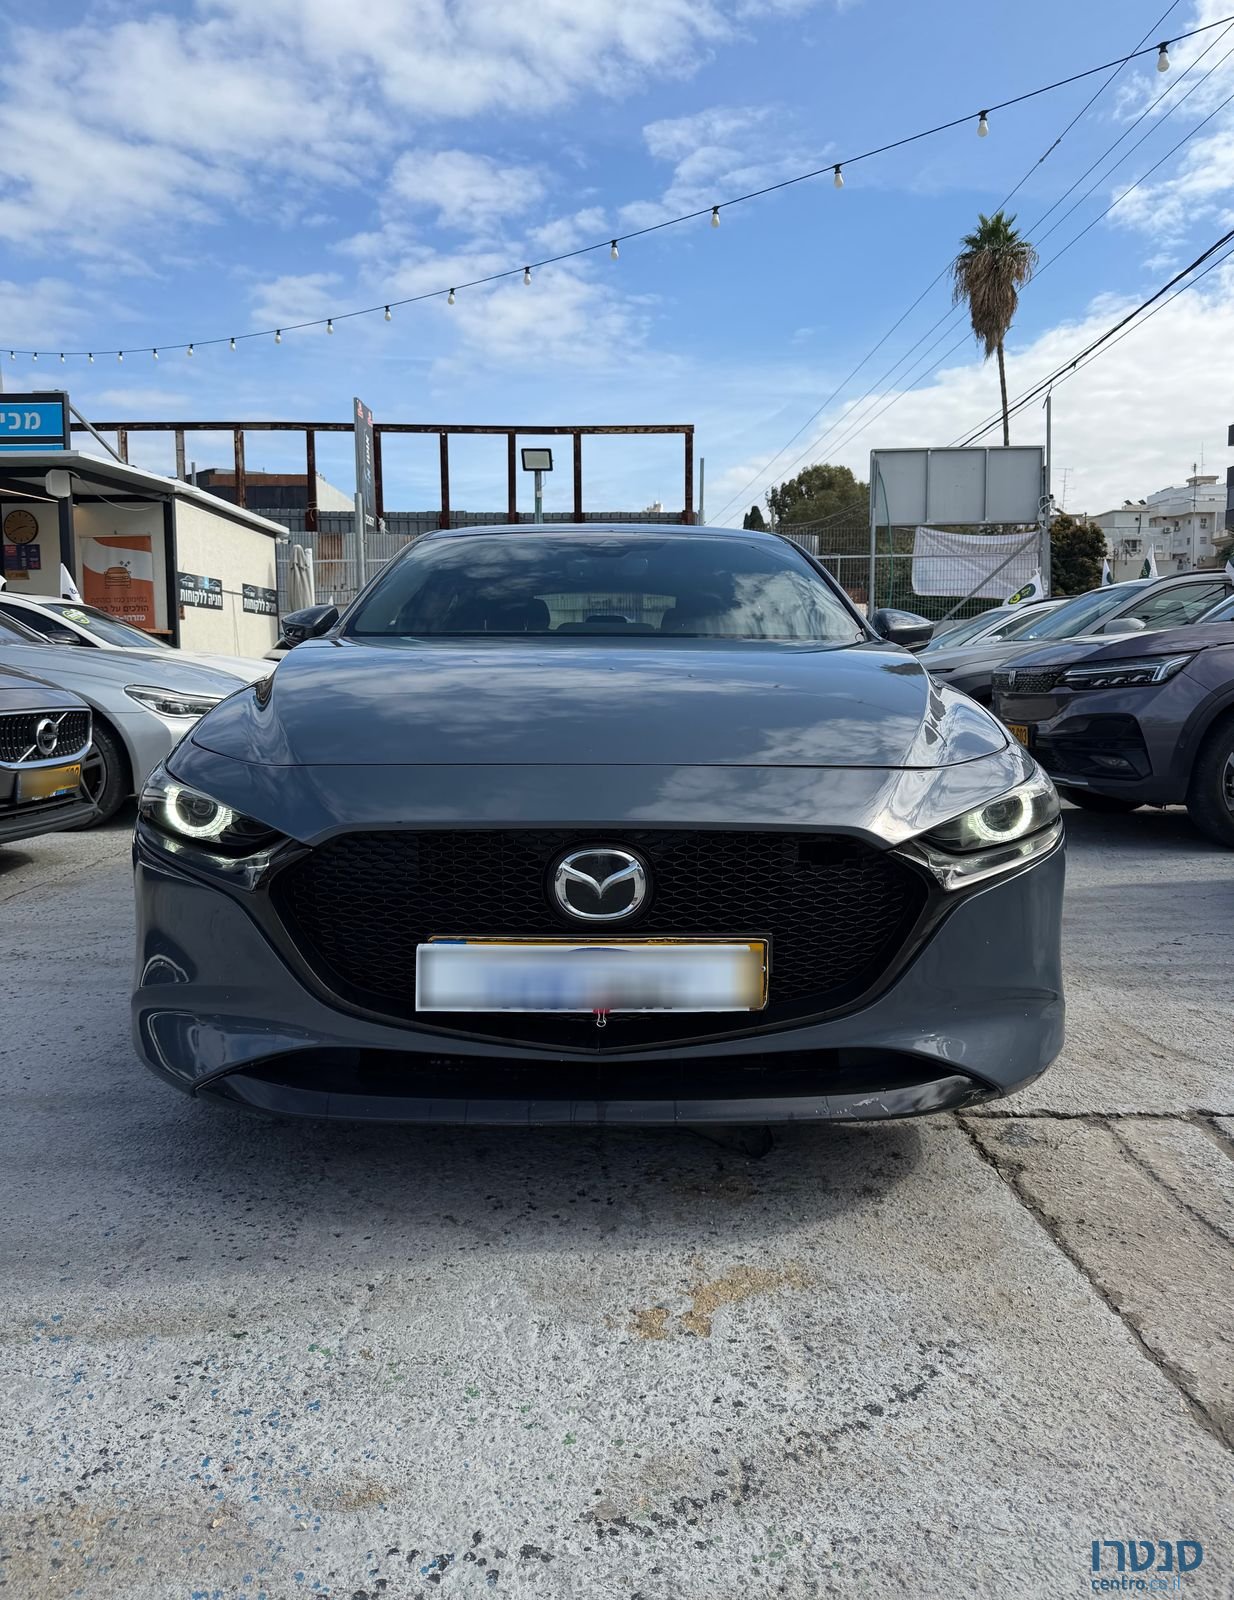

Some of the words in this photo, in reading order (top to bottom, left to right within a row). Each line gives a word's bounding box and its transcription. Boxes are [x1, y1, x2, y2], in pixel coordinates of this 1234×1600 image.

[0, 412, 41, 430] מכי
[180, 589, 207, 606] ללקוחות
[208, 593, 222, 606] חניה
